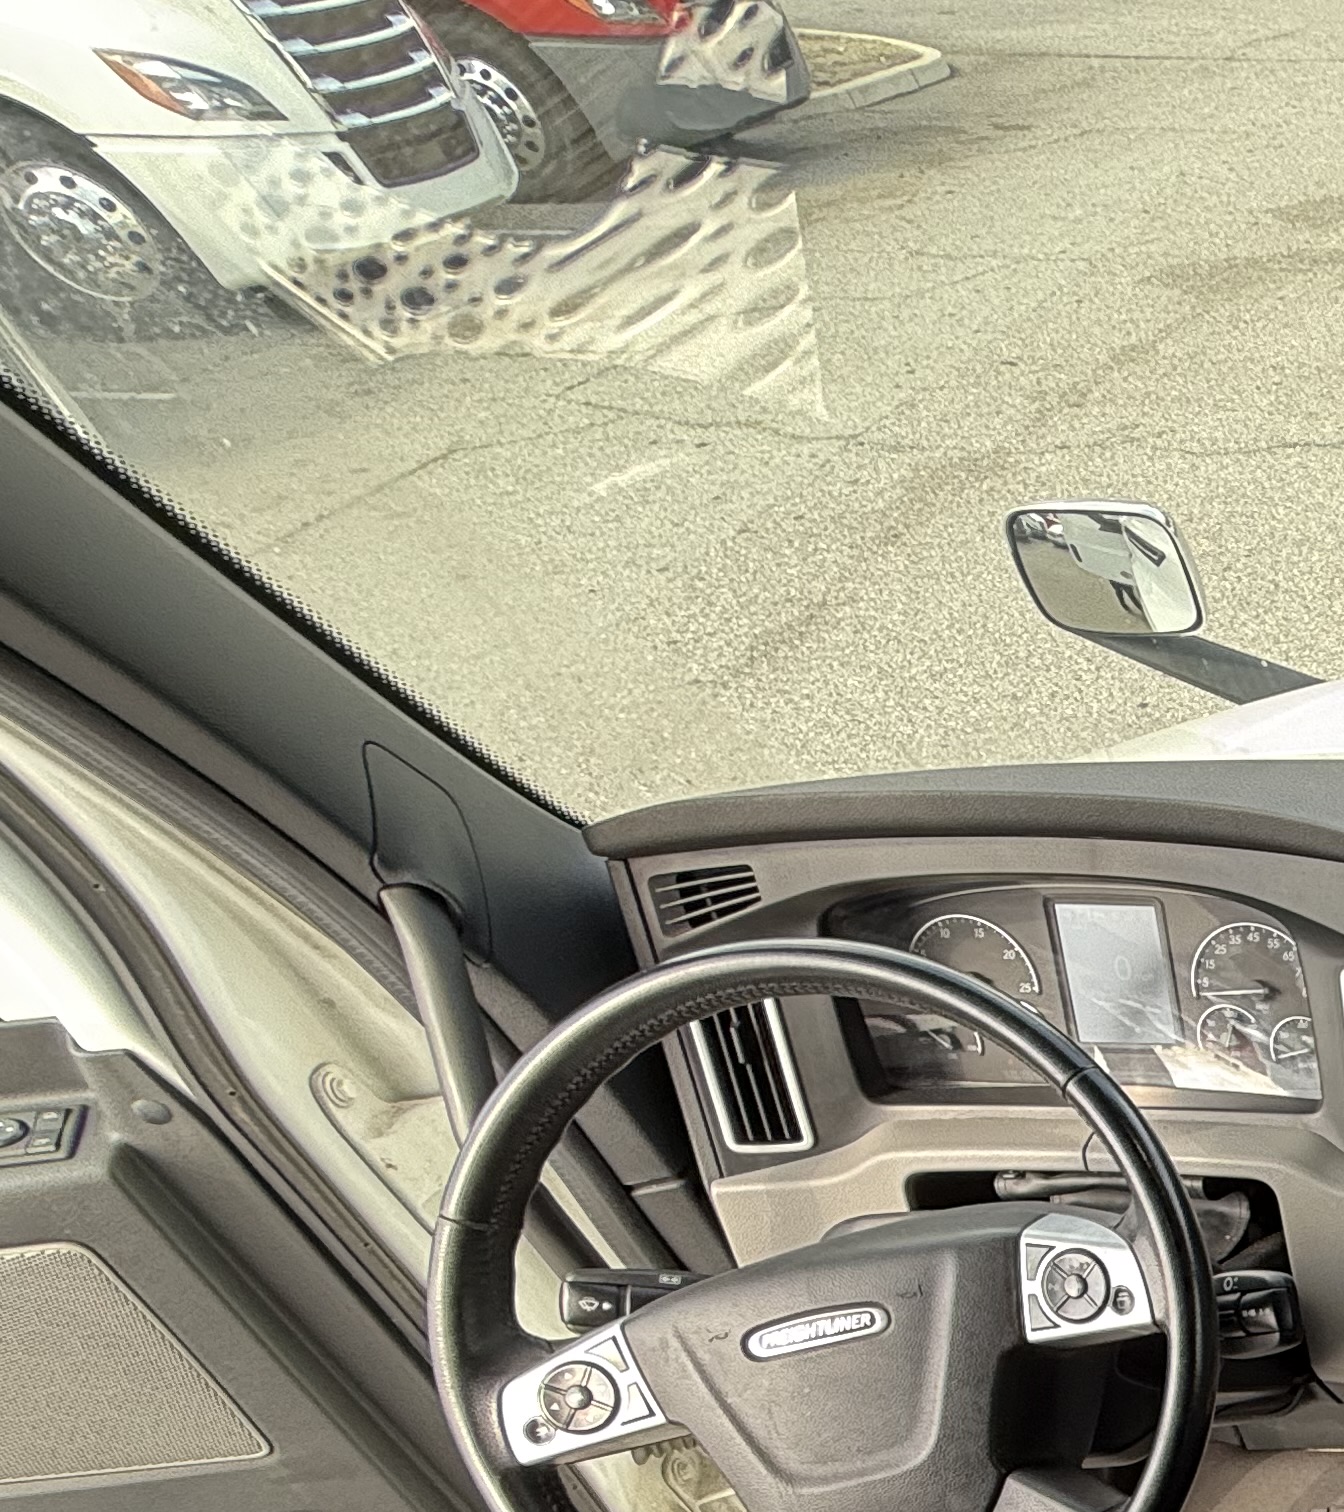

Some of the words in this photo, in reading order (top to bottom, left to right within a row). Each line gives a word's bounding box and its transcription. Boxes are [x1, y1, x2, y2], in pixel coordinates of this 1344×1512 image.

[940, 928, 950, 939] 10
[973, 928, 985, 939] 15
[1247, 932, 1260, 943] 45
[1229, 934, 1242, 945] 35
[1267, 938, 1280, 949] 55
[1003, 950, 1016, 960] 20
[1214, 944, 1227, 955] 25
[1283, 951, 1295, 962] 65
[1114, 955, 1132, 980] 0
[1205, 959, 1216, 970] 15
[1019, 982, 1032, 993] 25
[1202, 977, 1209, 988] 5
